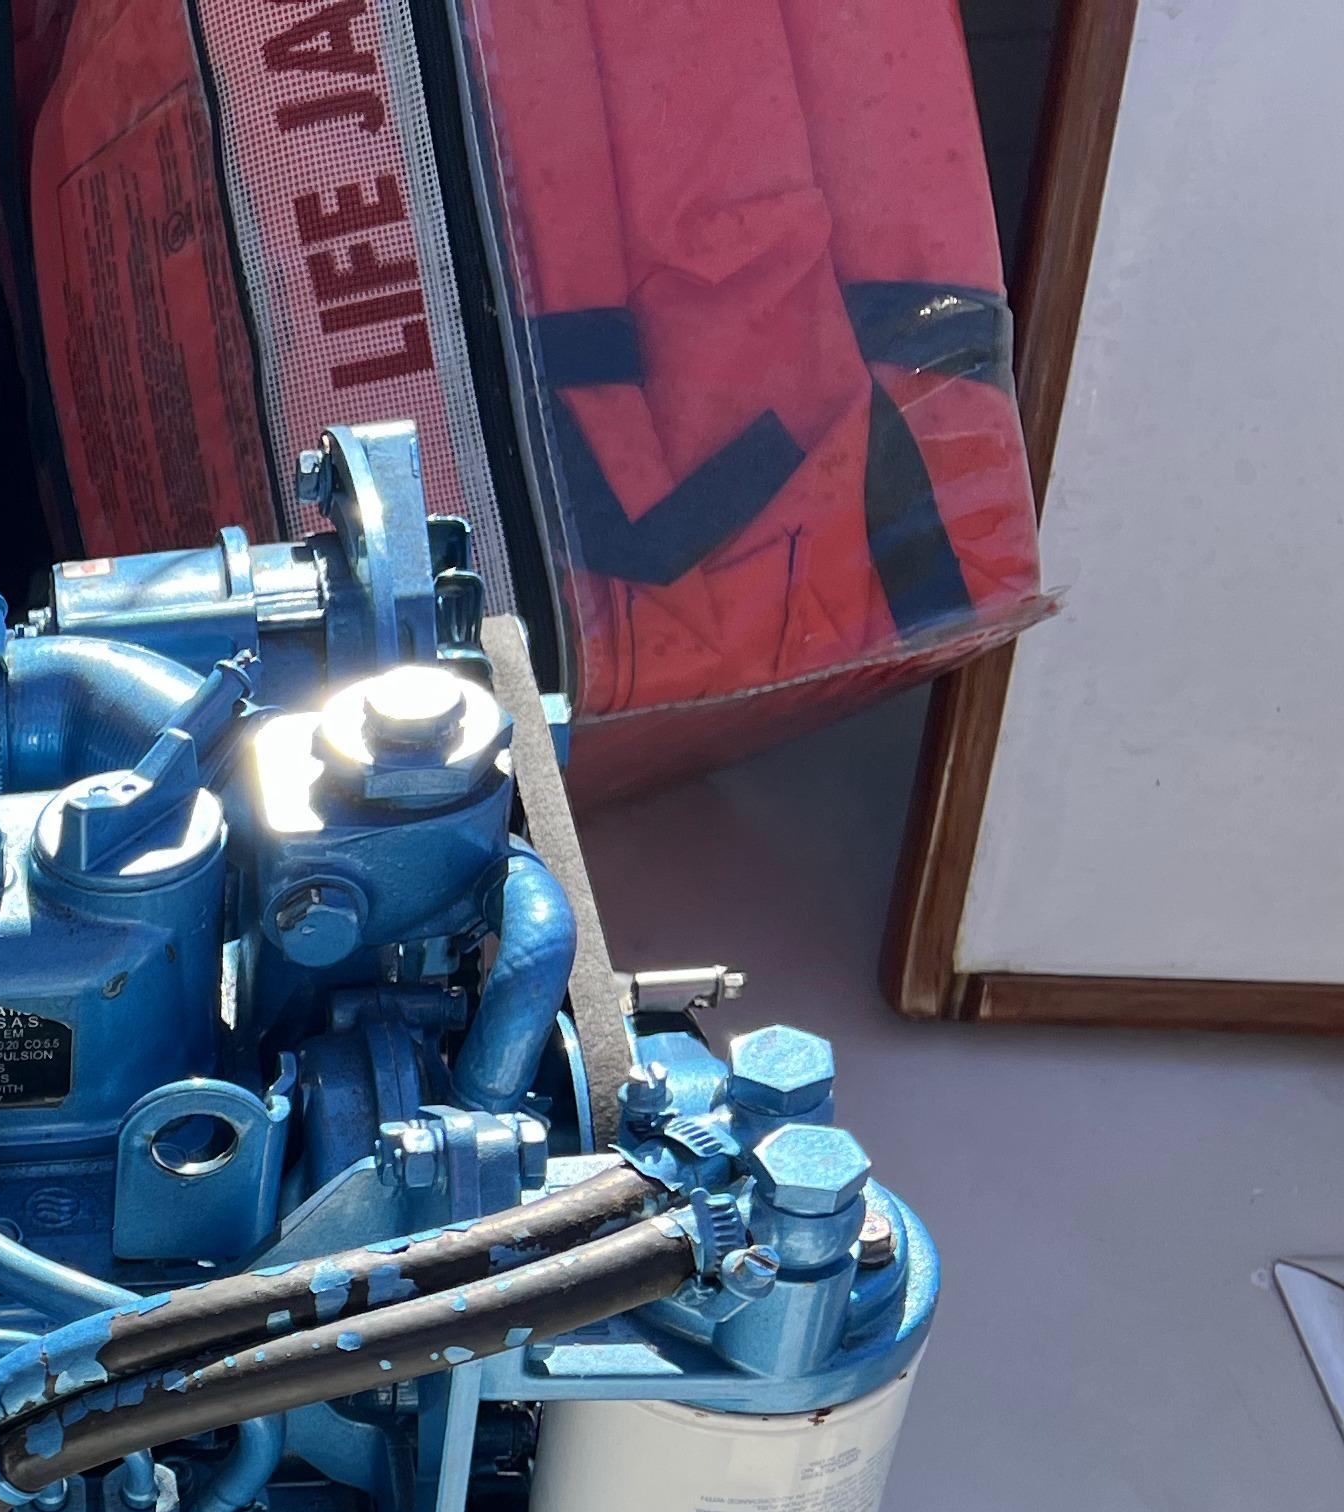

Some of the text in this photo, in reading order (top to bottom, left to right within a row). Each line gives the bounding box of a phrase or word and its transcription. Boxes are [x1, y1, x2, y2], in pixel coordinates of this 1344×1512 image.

[262, 0, 436, 389] LIFE JA
[3, 1028, 24, 1038] EM
